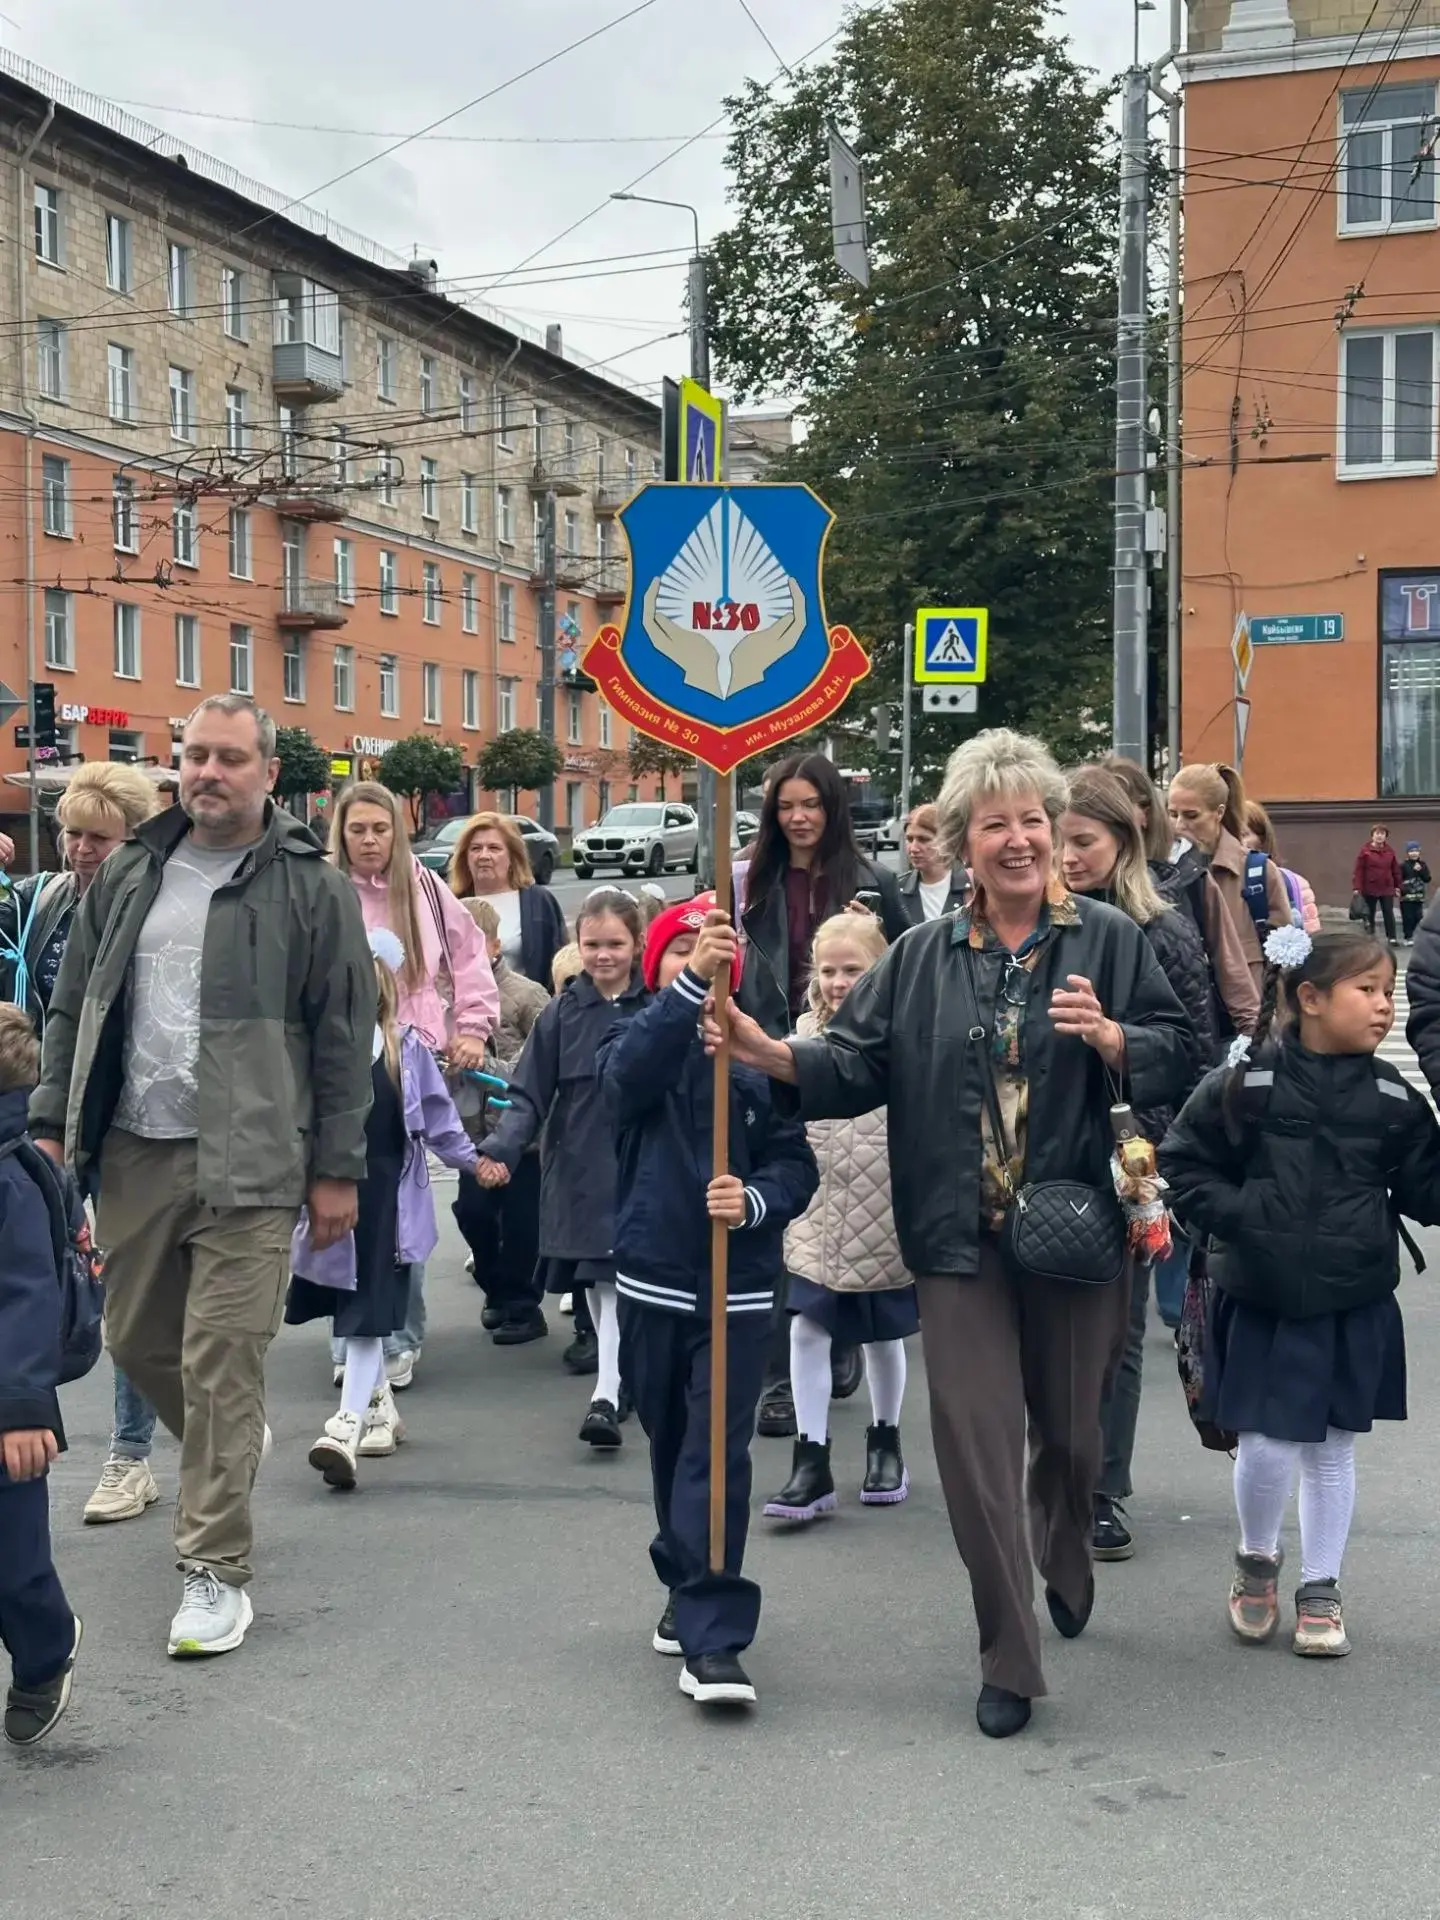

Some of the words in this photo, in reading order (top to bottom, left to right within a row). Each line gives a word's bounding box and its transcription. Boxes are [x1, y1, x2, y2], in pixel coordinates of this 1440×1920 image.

[1324, 619, 1336, 635] 19
[608, 676, 661, 724] Гимназия
[663, 718, 680, 733] №
[681, 728, 700, 744] 30
[745, 731, 767, 746] им.
[768, 696, 825, 733] Музалева
